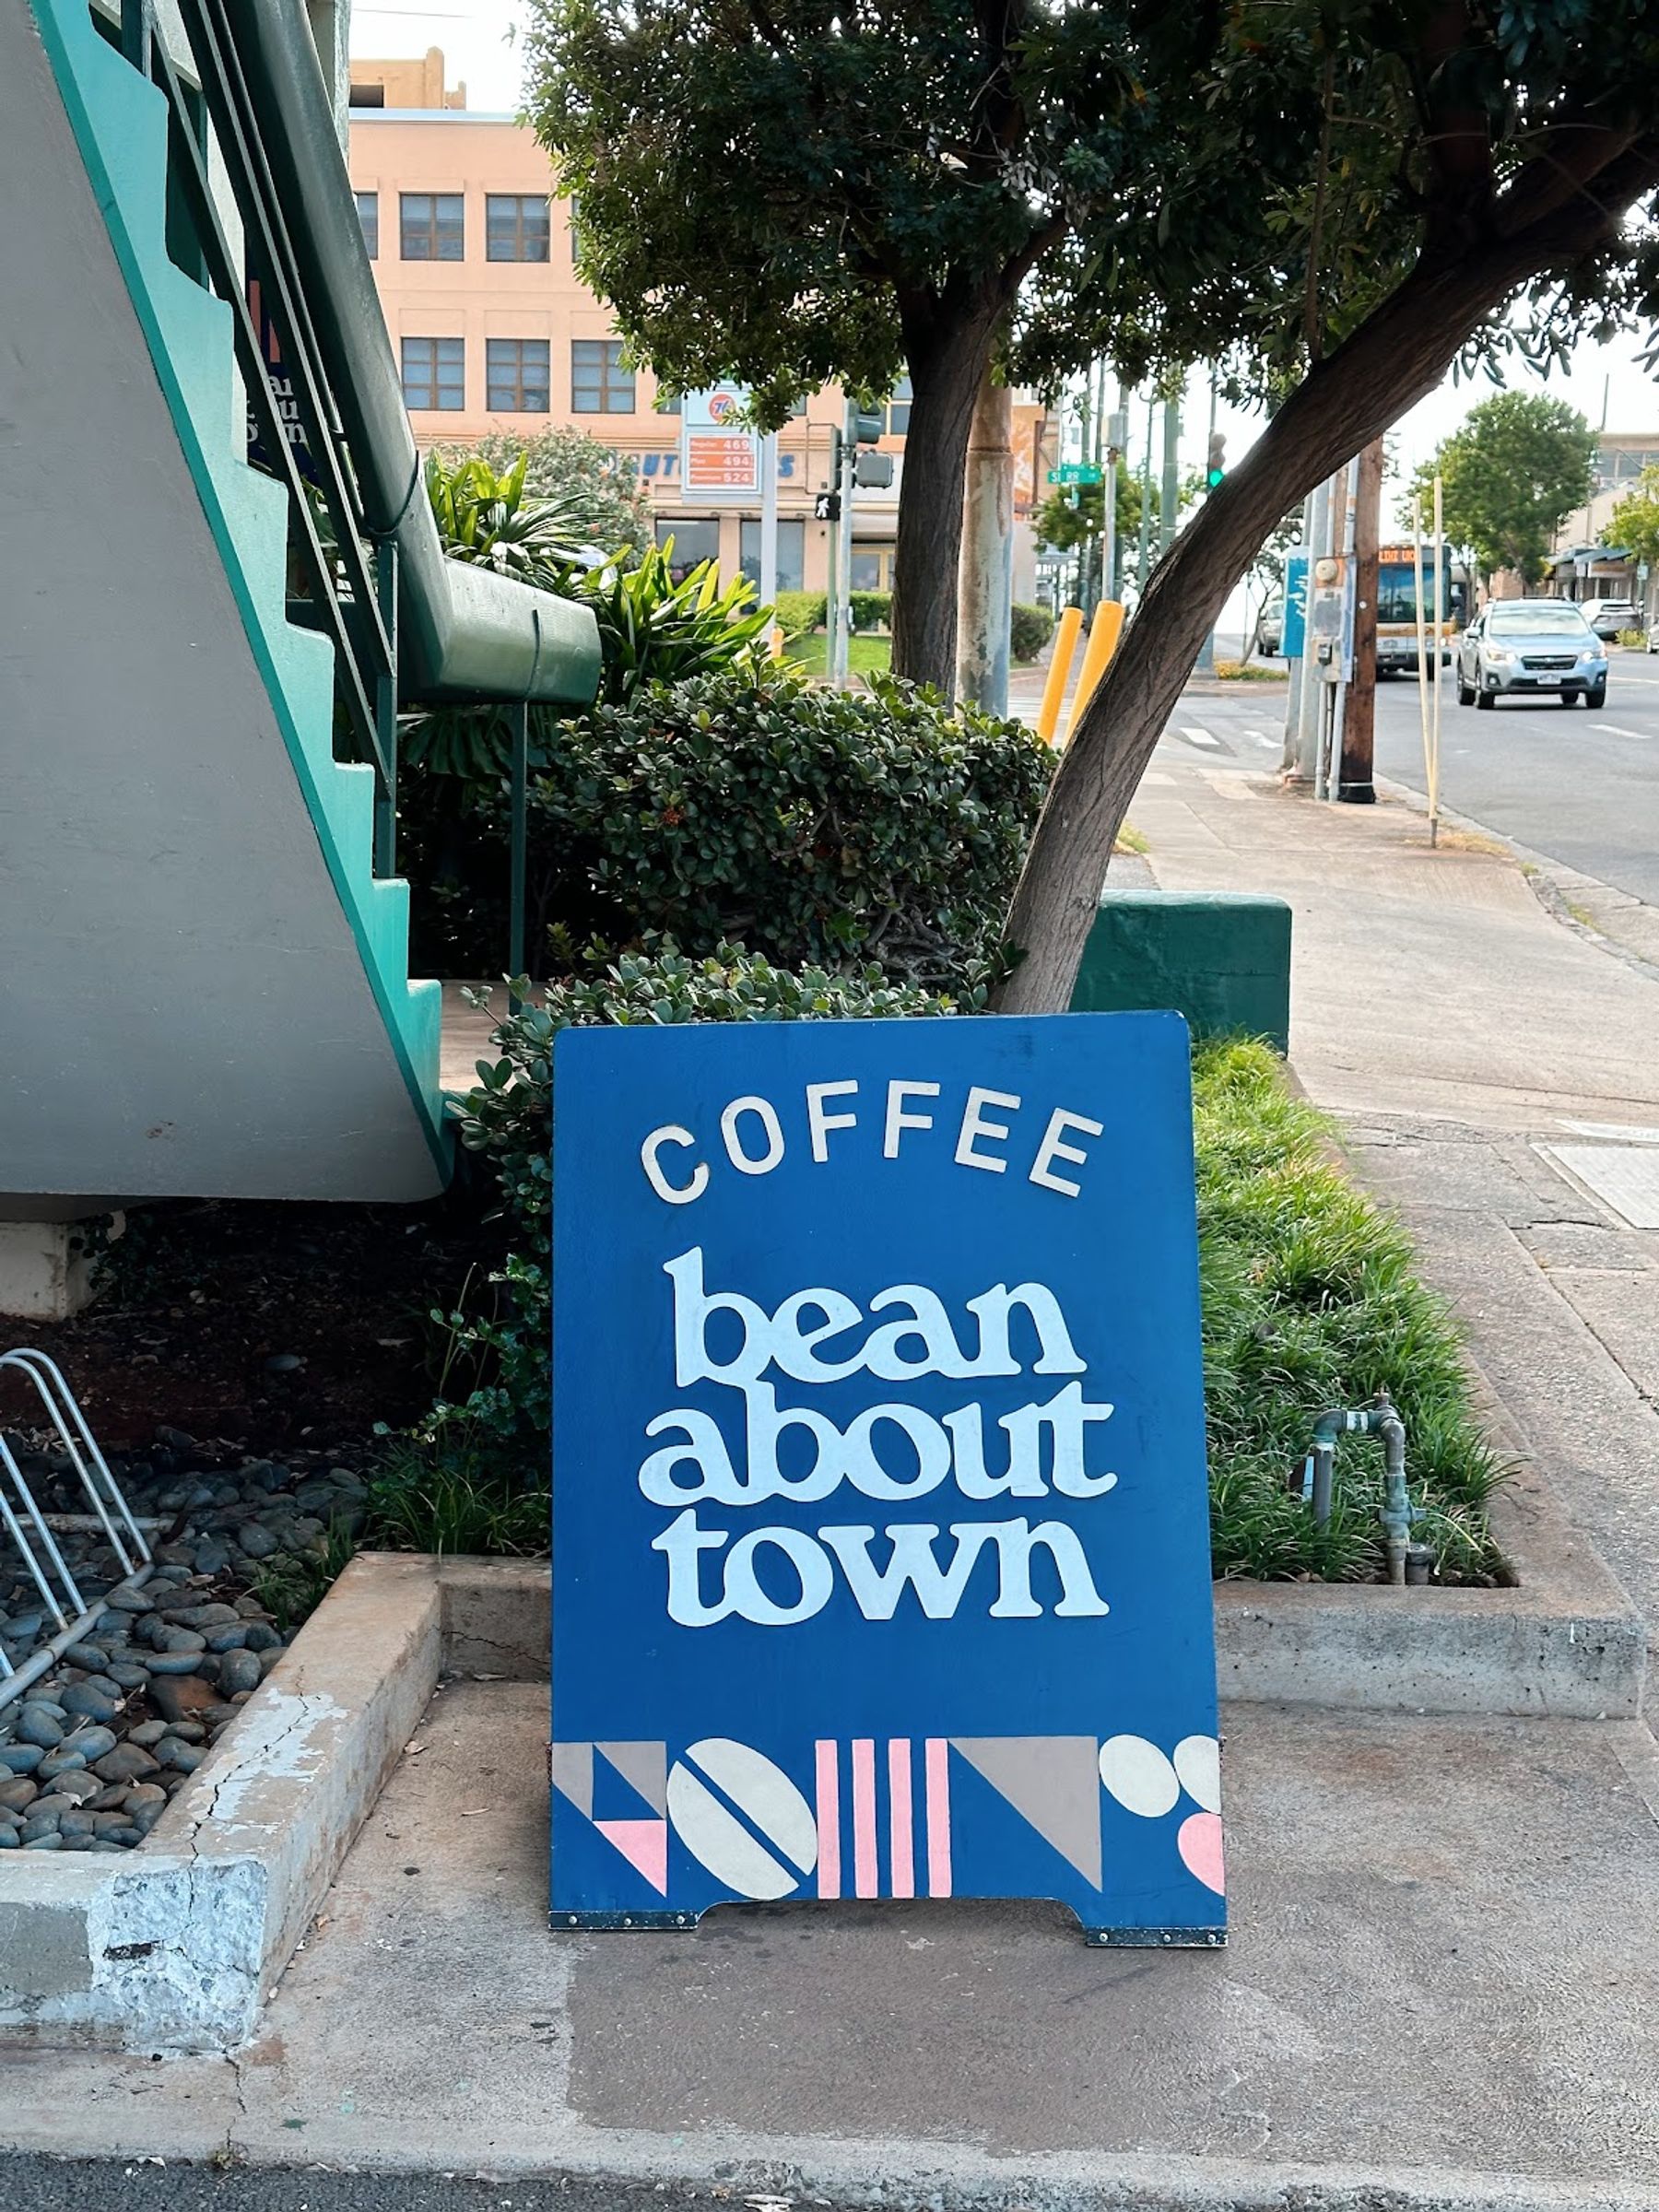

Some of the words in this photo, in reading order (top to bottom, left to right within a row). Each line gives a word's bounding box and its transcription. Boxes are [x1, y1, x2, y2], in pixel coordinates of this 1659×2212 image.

[724, 440, 749, 451] 469
[724, 456, 749, 466] 494
[724, 473, 750, 483] 524
[641, 1079, 1104, 1204] COFFEE
[663, 1246, 1088, 1387] bean
[639, 1380, 1118, 1507] about
[652, 1509, 1110, 1628] town
